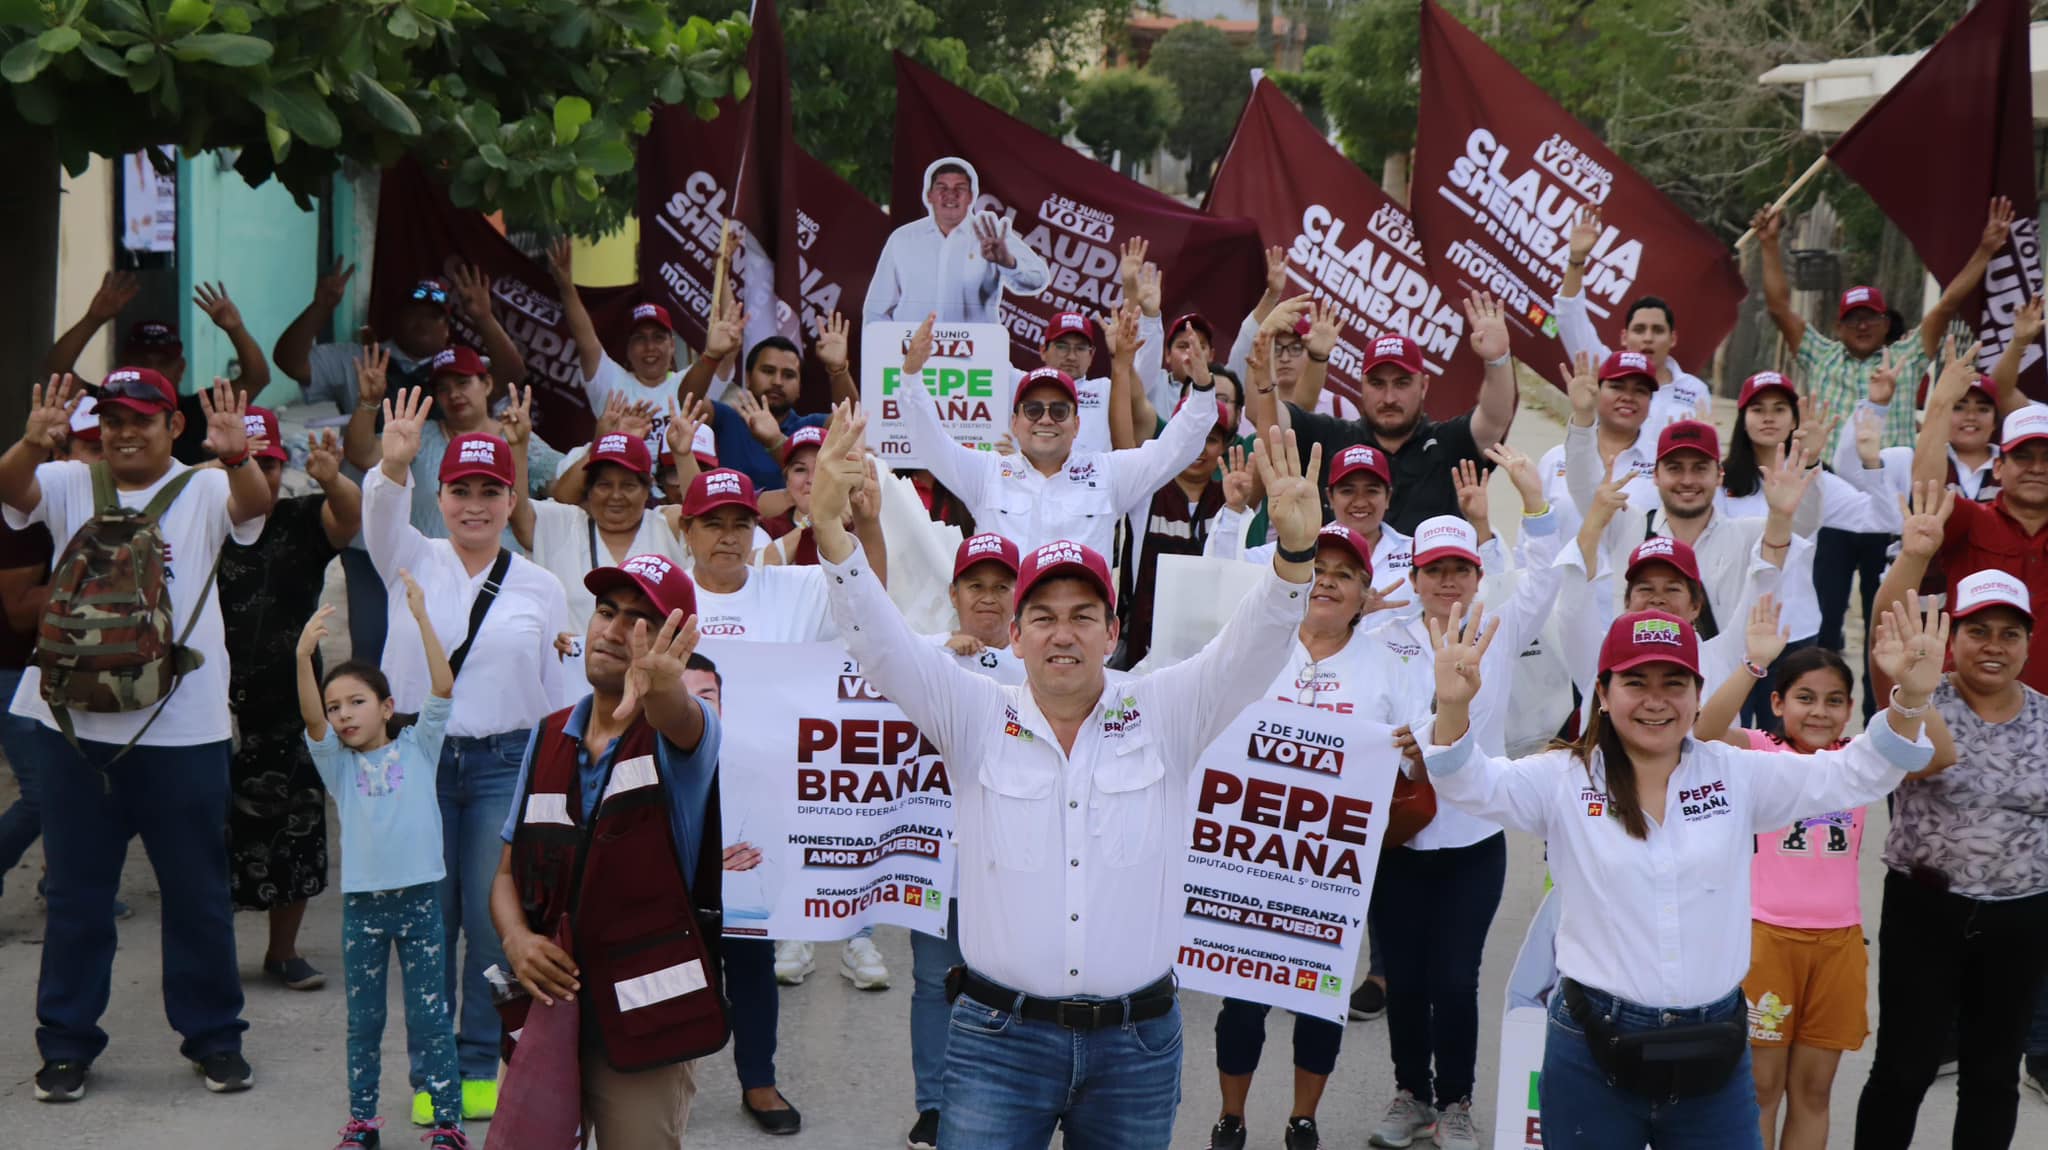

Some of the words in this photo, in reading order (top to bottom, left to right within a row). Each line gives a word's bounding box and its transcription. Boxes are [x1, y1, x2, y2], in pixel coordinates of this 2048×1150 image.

[1541, 144, 1603, 204] VOTA
[1043, 203, 1108, 240] VOTA
[1077, 203, 1114, 223] JUNIO
[1303, 204, 1464, 337] CLAUDIA
[1445, 240, 1530, 315] morena
[1288, 233, 1461, 362] SHEINBAUM
[460, 450, 494, 460] BRAÑA
[461, 440, 495, 452] PEPE
[706, 472, 739, 483] PEPE
[969, 534, 1002, 545] PEPE
[1423, 526, 1466, 539] morena
[1037, 549, 1082, 564] BRAÑA
[1038, 542, 1082, 556] PEPE
[1970, 582, 2019, 595] morena
[703, 625, 743, 634] VOTA
[1635, 621, 1680, 633] PEPE
[1635, 631, 1681, 643] BRAÑA
[844, 662, 852, 672] 2
[1257, 720, 1267, 732] 2
[1271, 723, 1291, 738] DE
[1296, 728, 1345, 749] JUNIO
[1254, 735, 1340, 773] VOTA
[798, 756, 952, 803] BRAÑA
[1679, 780, 1726, 804] PEPE
[798, 806, 852, 817] DIPUTADO
[856, 803, 898, 817] FEDERAL
[908, 797, 951, 809] DISTRITO
[1197, 768, 1372, 846] PEPE
[1682, 795, 1729, 816] BRAÑA
[788, 834, 877, 847] HONESTIDAD,
[879, 824, 943, 843] ESPERANZA
[808, 851, 858, 865] AMOR
[862, 849, 880, 864] AL
[881, 838, 936, 857] PUEBLO
[1190, 818, 1362, 884] BRAÑA
[816, 887, 858, 896] SIGAMOS
[859, 873, 893, 893] HACIENDO
[894, 872, 934, 886] HISTORIA
[1187, 854, 1244, 874] DIPUTADO
[1246, 866, 1296, 885] FEDERAL
[1311, 879, 1360, 897] DISTRITO
[804, 884, 900, 919] morena
[906, 891, 921, 905] PT
[1267, 898, 1348, 926] ESPERANZA
[1352, 917, 1361, 929] Y
[1191, 900, 1242, 922] AMOR
[1245, 912, 1268, 928] AL
[1272, 917, 1338, 941] PUEBLO
[1193, 937, 1235, 954] SIGAMOS
[1237, 946, 1286, 963] HACIENDO
[1288, 956, 1332, 972] HISTORIA
[1177, 945, 1290, 986] morena
[1297, 976, 1316, 990] PT
